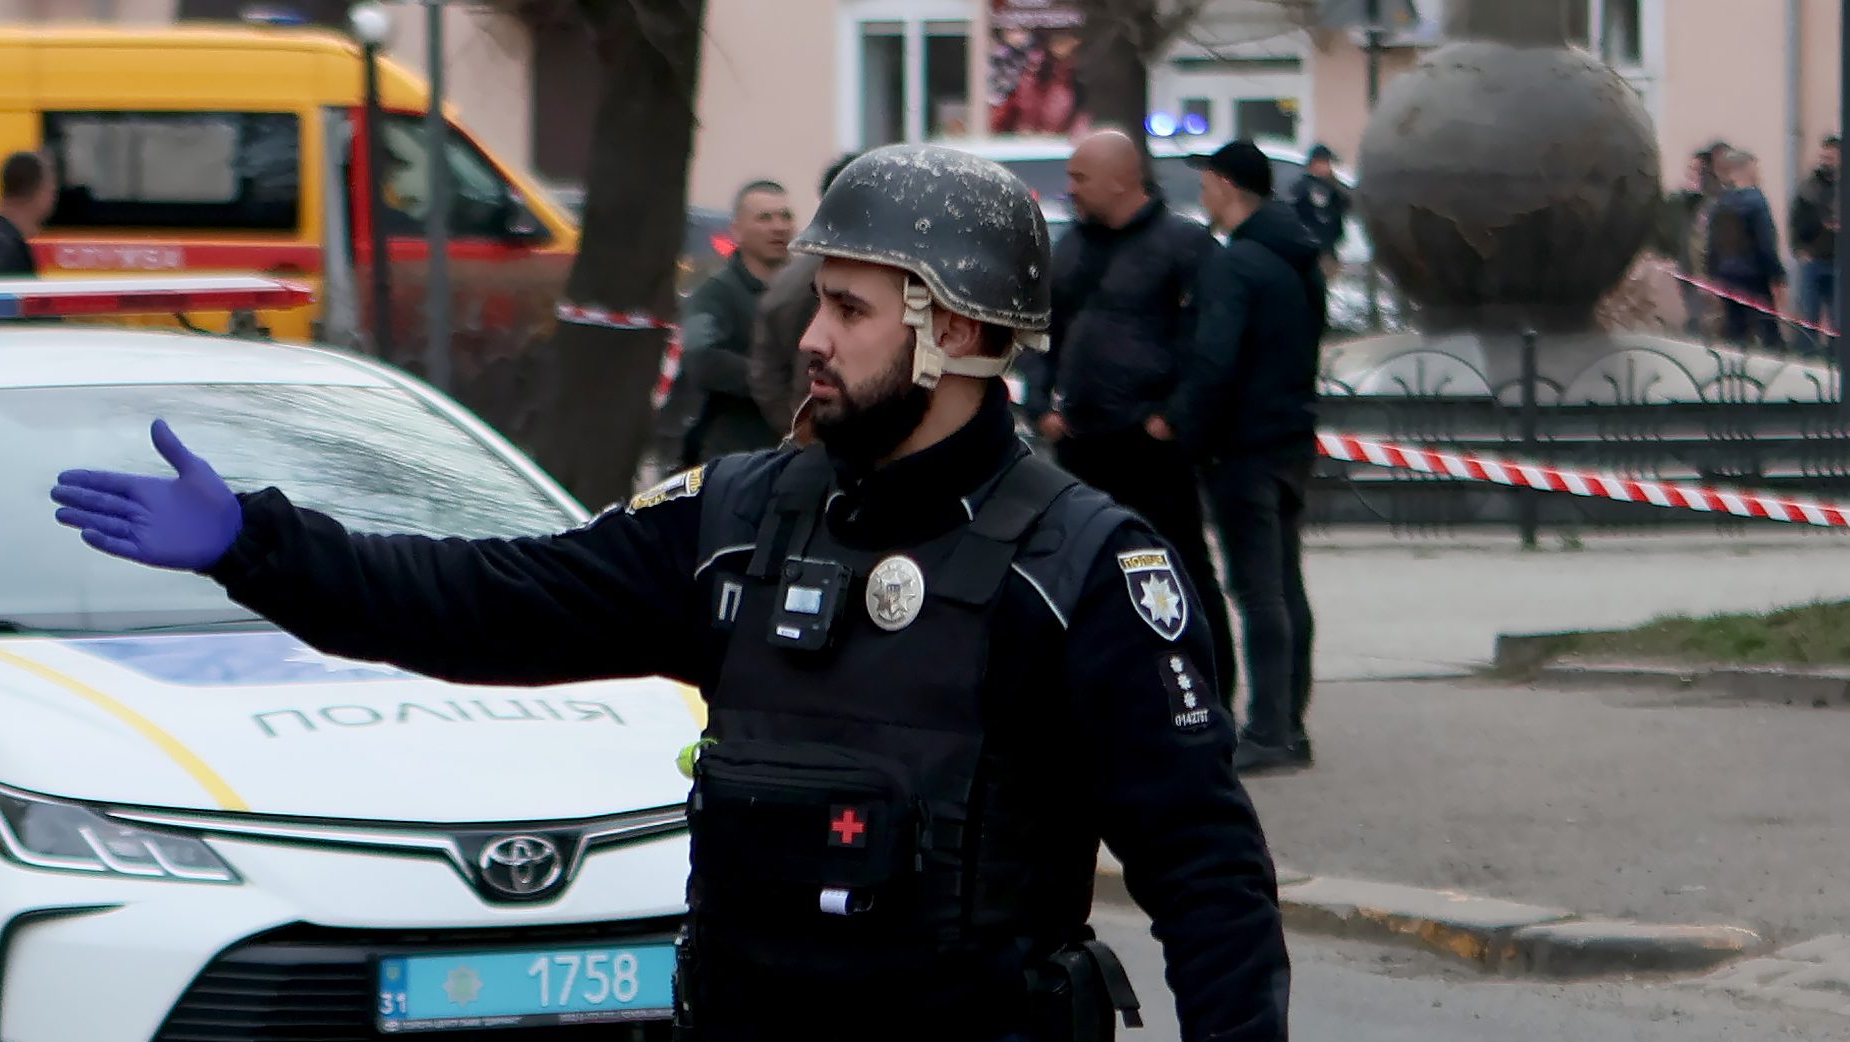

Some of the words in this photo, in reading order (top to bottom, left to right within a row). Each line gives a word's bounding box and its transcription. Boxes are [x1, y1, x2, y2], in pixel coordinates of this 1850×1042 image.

[250, 699, 628, 738] ПОЛІЦІЯ
[527, 953, 640, 1007] 1758
[379, 991, 407, 1015] 31
